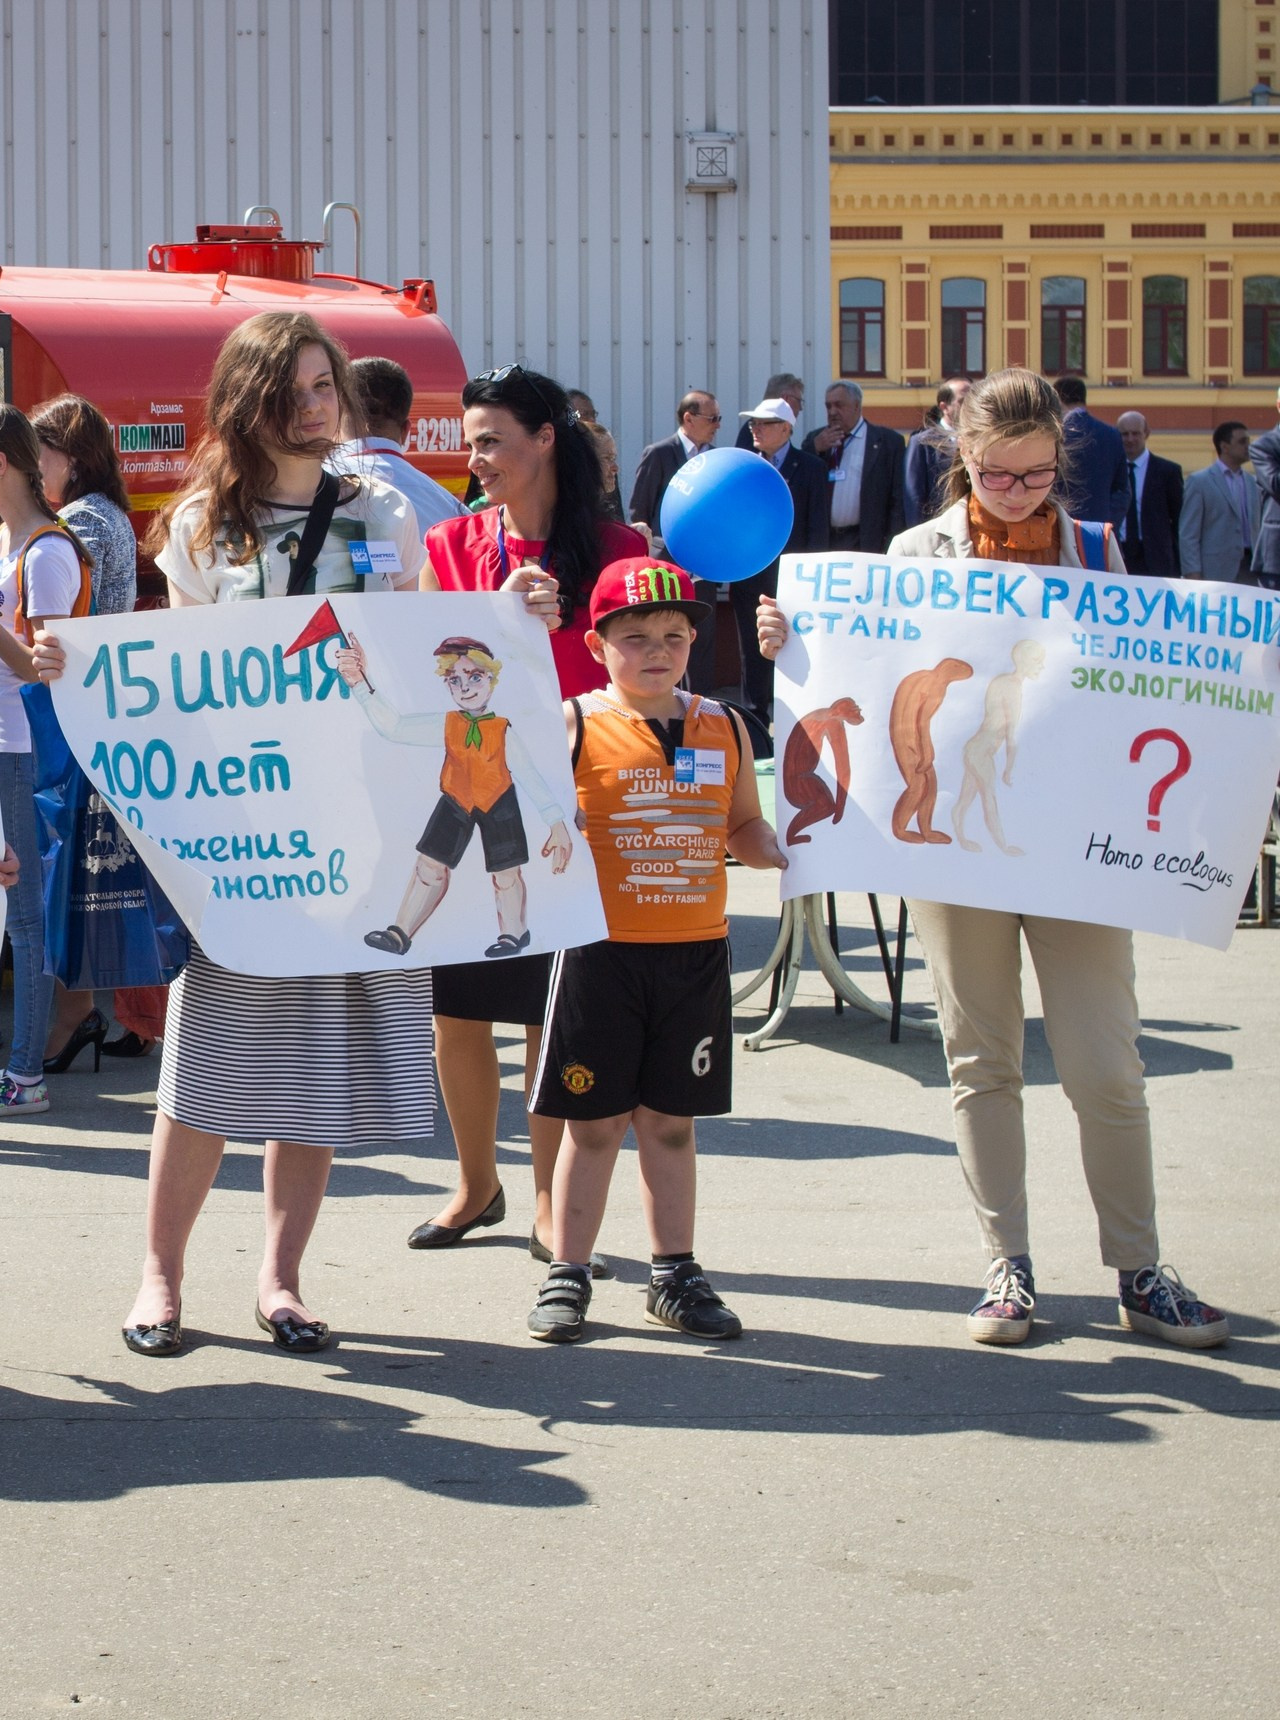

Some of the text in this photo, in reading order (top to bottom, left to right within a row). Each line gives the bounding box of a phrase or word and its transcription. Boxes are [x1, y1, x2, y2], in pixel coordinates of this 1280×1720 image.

[150, 401, 184, 416] Арзамас
[120, 424, 184, 452] КОММАШ
[120, 458, 184, 474] .kommash.ru
[796, 562, 1028, 618] ЧЕЛОВЕК
[792, 611, 922, 641] СТАНЬ
[1072, 633, 1243, 675] ЧЕЛОВЕКОМ
[83, 640, 160, 719] 15
[1071, 667, 1275, 716] ЭКОЛОГИЧНЫМ
[90, 739, 176, 800] 100
[617, 768, 661, 780] BICCI
[628, 779, 702, 794] JUNIOR
[653, 836, 719, 849] ARCHIVES
[688, 848, 716, 859] PARIS
[631, 862, 674, 874] GOOD
[1086, 832, 1234, 892] Homo ecologus
[123, 889, 145, 899] СОБРА
[618, 883, 641, 893] NO.1
[676, 894, 707, 904] FASHION
[692, 1036, 713, 1077] 6
